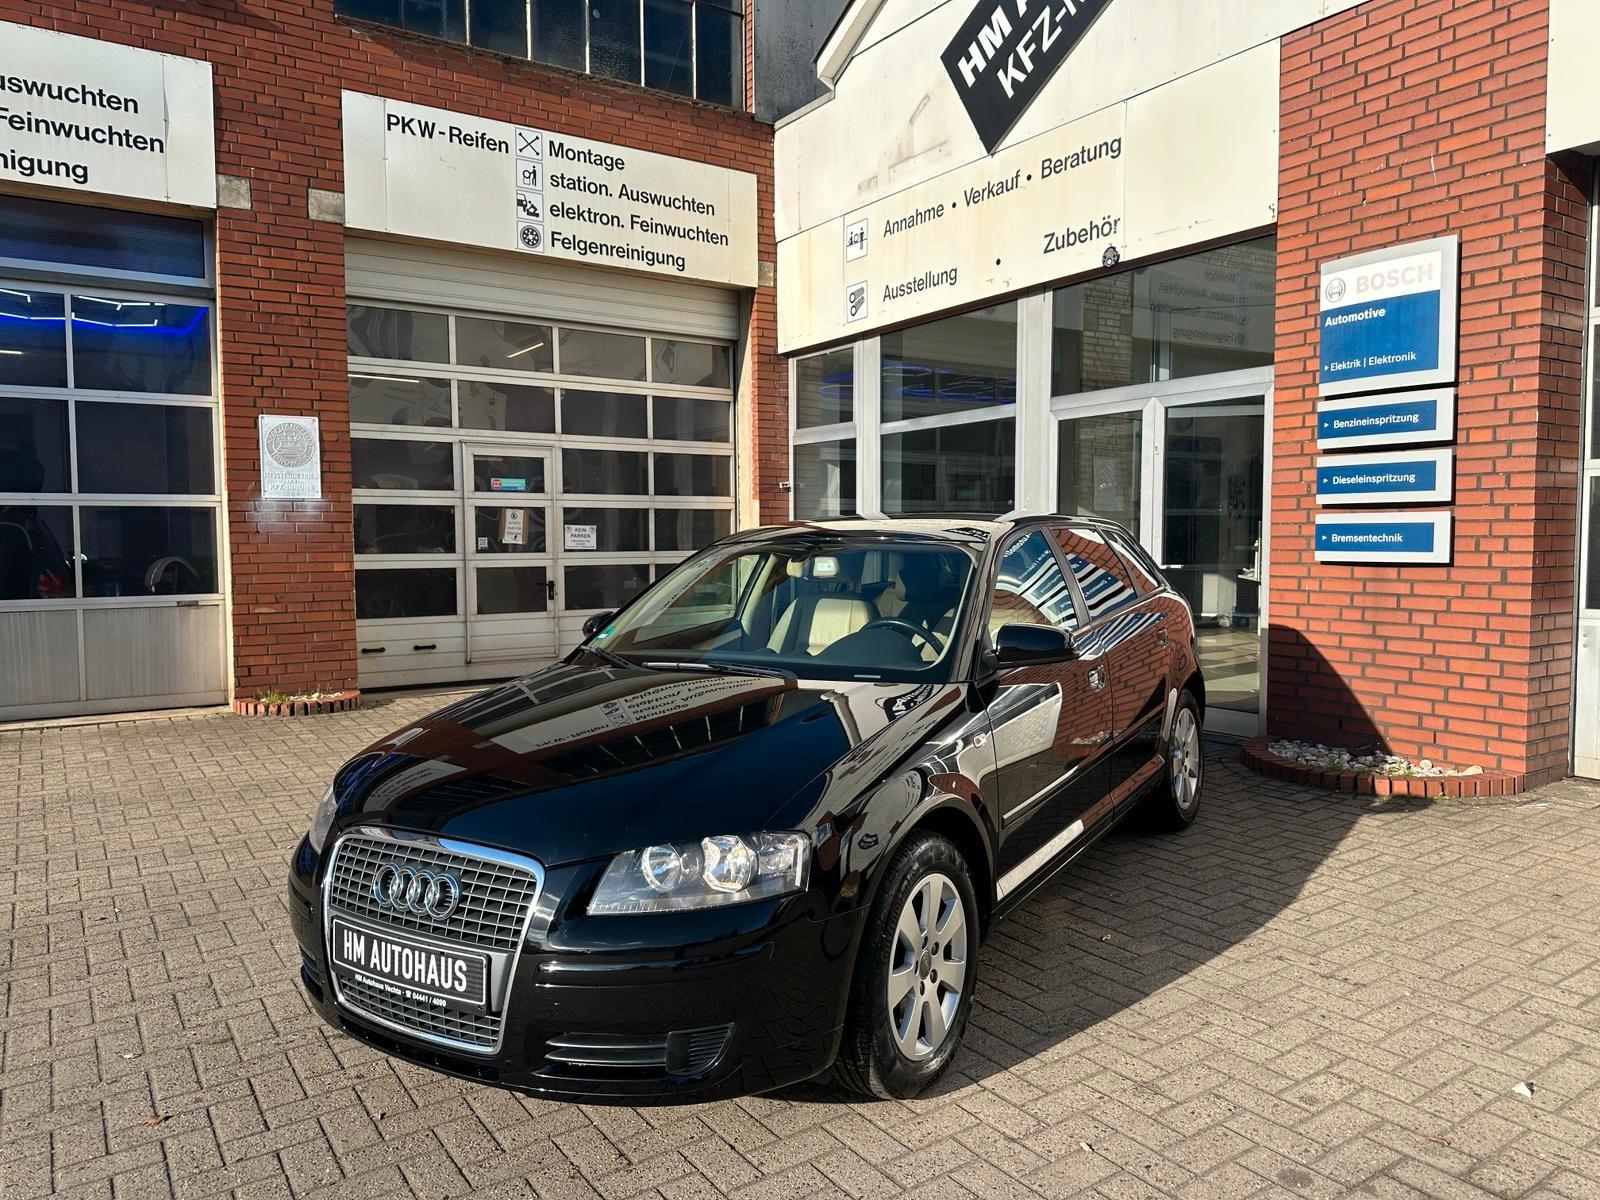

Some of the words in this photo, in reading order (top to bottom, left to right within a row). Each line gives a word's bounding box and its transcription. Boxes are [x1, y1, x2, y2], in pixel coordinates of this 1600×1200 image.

[957, 4, 1012, 88] HM
[386, 113, 509, 153] PKW-Reifen
[548, 140, 625, 171] Montage
[550, 173, 613, 197] station.
[618, 184, 715, 216] Auswuchten
[883, 202, 945, 238] Annahme
[963, 170, 1021, 207] Verkauf
[1041, 137, 1122, 179] Beratung
[550, 202, 625, 228] elektron.
[630, 214, 729, 246] Feinwuchten
[550, 231, 686, 271] Felgenreinigung
[883, 267, 958, 302] Ausstellung
[1043, 215, 1121, 254] Zubehör
[1355, 262, 1433, 294] BOSCH
[1324, 307, 1386, 328] Automotive
[1330, 358, 1361, 372] Elektrik
[1368, 351, 1417, 366] Elektronik
[1333, 412, 1420, 429] Benzineinspritzung
[1332, 472, 1416, 485] Dieseleinspritzung
[1331, 533, 1403, 543] Bremsentechnik
[343, 929, 365, 965] HM
[370, 939, 467, 992] AUTOHAUS
